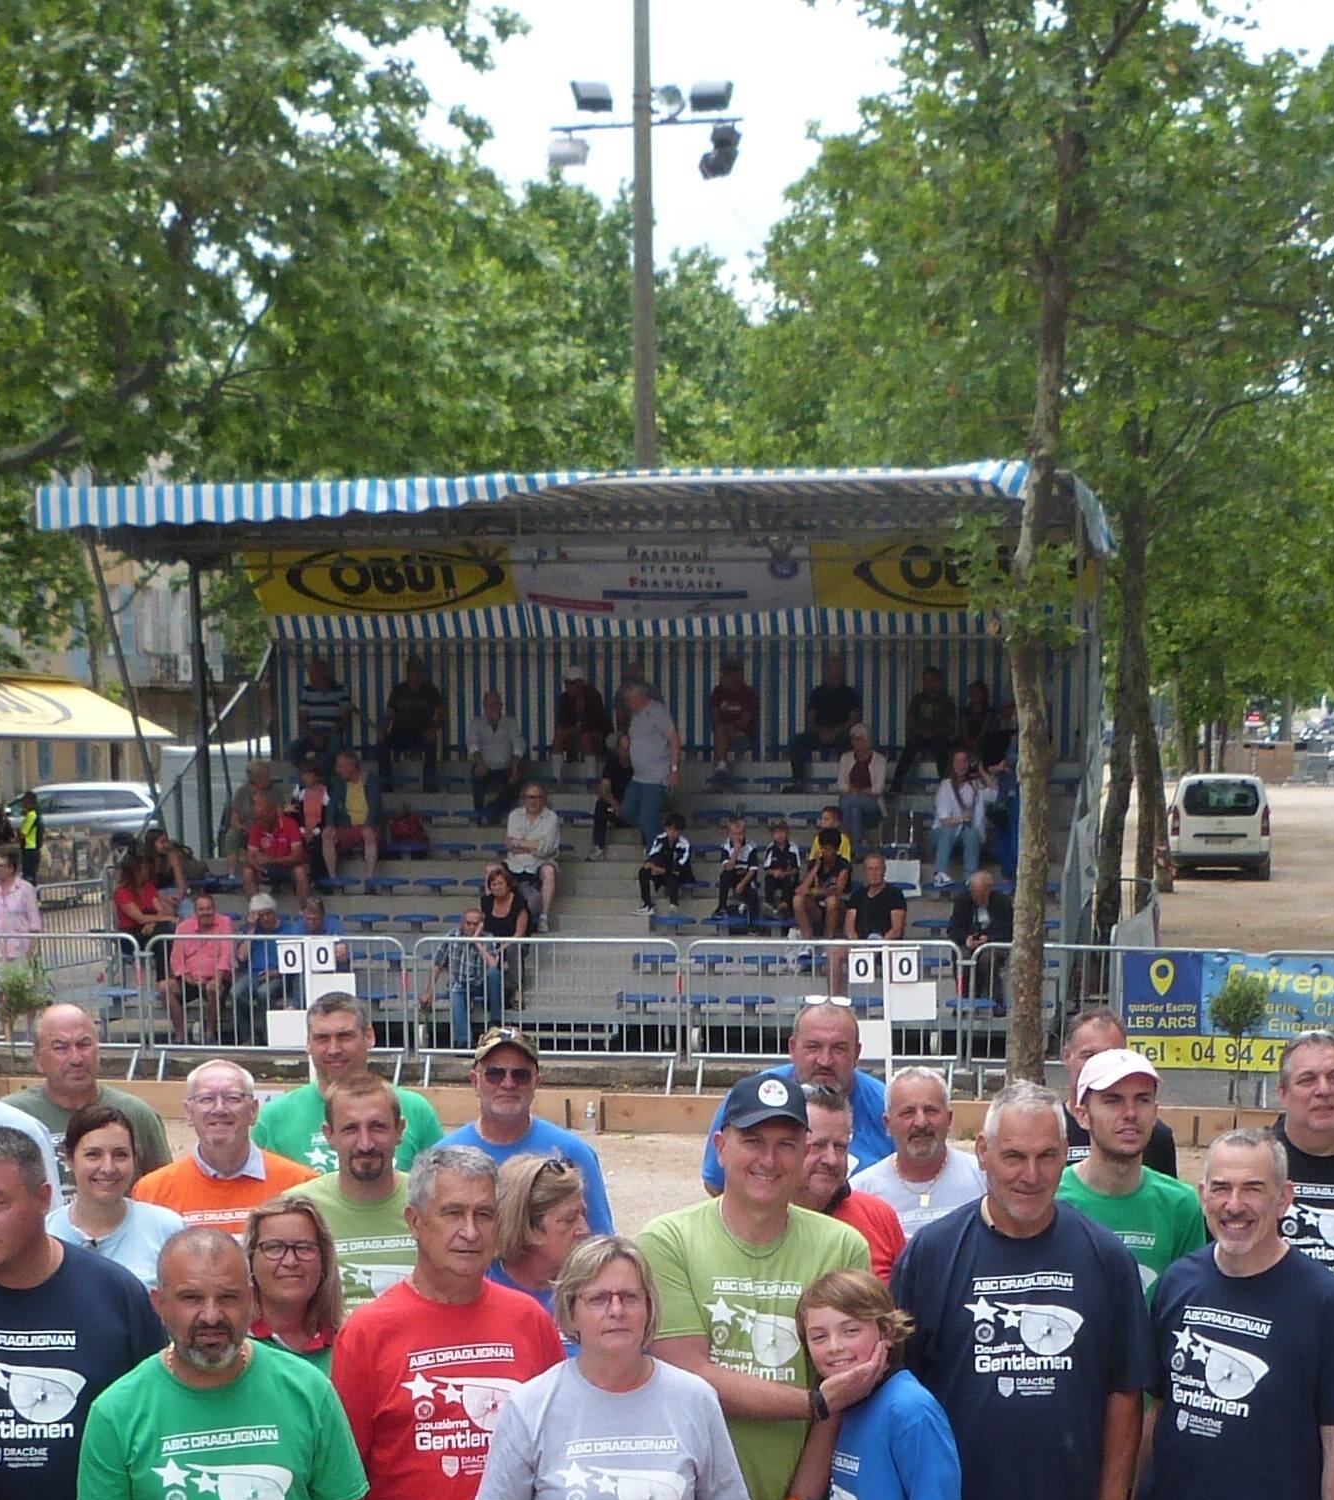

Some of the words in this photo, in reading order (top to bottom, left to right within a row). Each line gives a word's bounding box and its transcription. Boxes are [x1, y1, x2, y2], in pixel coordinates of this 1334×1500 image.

[329, 555, 459, 598] OBUT
[283, 946, 299, 967] 0
[315, 944, 330, 965] 0
[855, 955, 870, 977] 0
[898, 956, 913, 977] 0
[1127, 1016, 1155, 1028] LES
[1157, 1016, 1197, 1028] ARCS
[1190, 1042, 1216, 1063] 04
[1224, 1044, 1253, 1065] 94
[973, 1281, 999, 1292] ABC
[999, 1276, 1074, 1290] DRAGUIGNAN
[409, 1353, 436, 1369] ABC
[436, 1346, 515, 1363] DRAGUIGNAN
[974, 1353, 1073, 1373] Gentlemen
[161, 1438, 190, 1453] ABC
[190, 1428, 279, 1449] DRAGUIGNAN
[593, 1439, 678, 1454] DRAGUIGNAN
